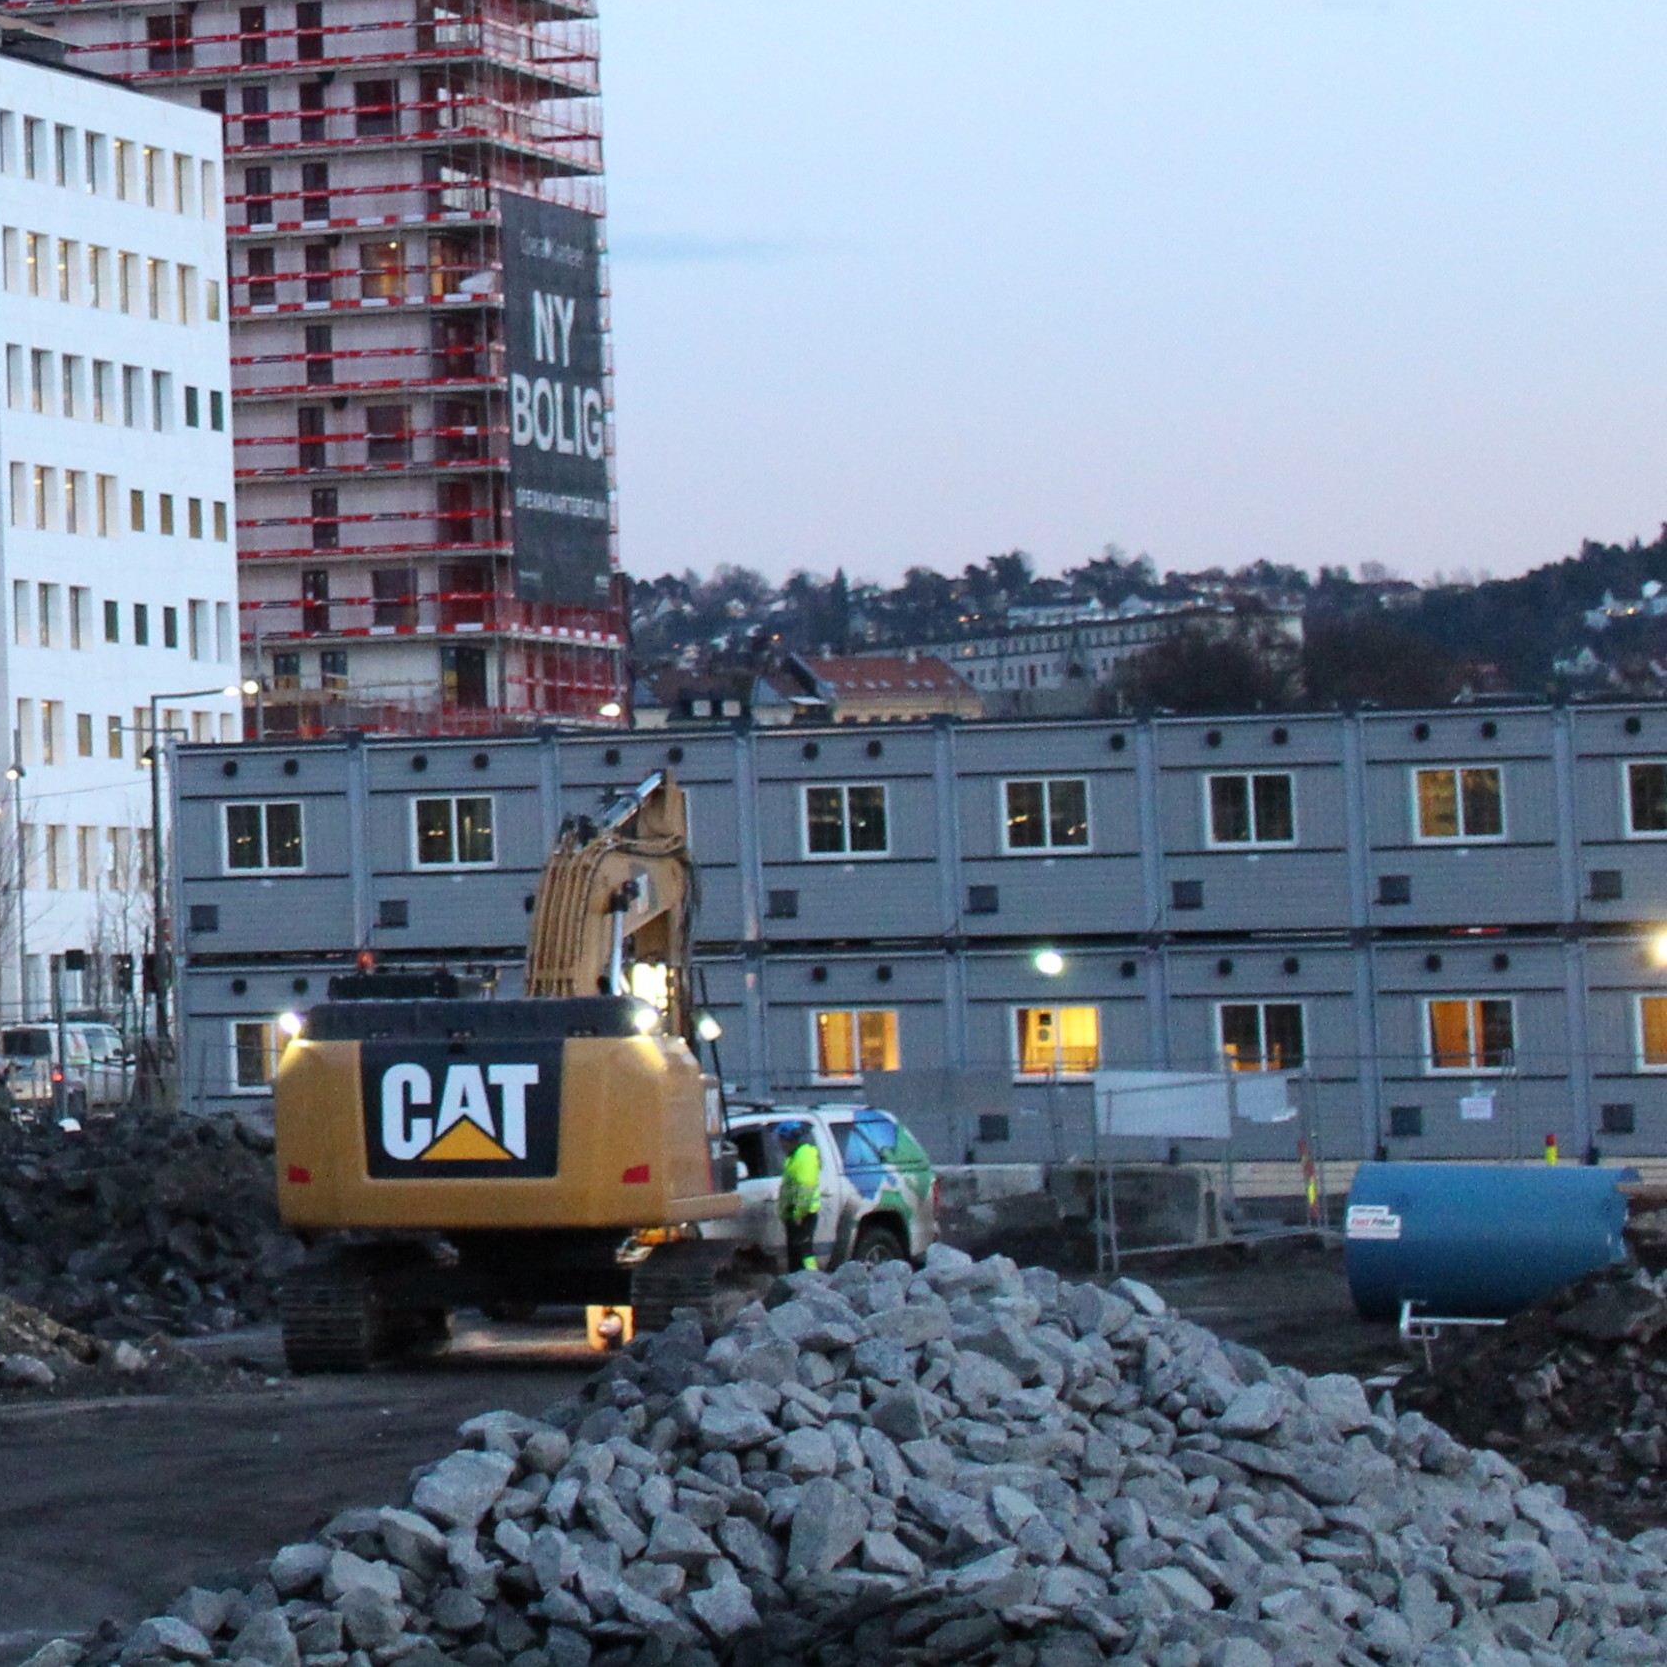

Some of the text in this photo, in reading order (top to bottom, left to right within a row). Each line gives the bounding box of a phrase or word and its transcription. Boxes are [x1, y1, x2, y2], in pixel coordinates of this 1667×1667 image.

[532, 289, 575, 368] NY
[510, 372, 604, 462] BOLIG
[381, 1062, 539, 1161] CAT
